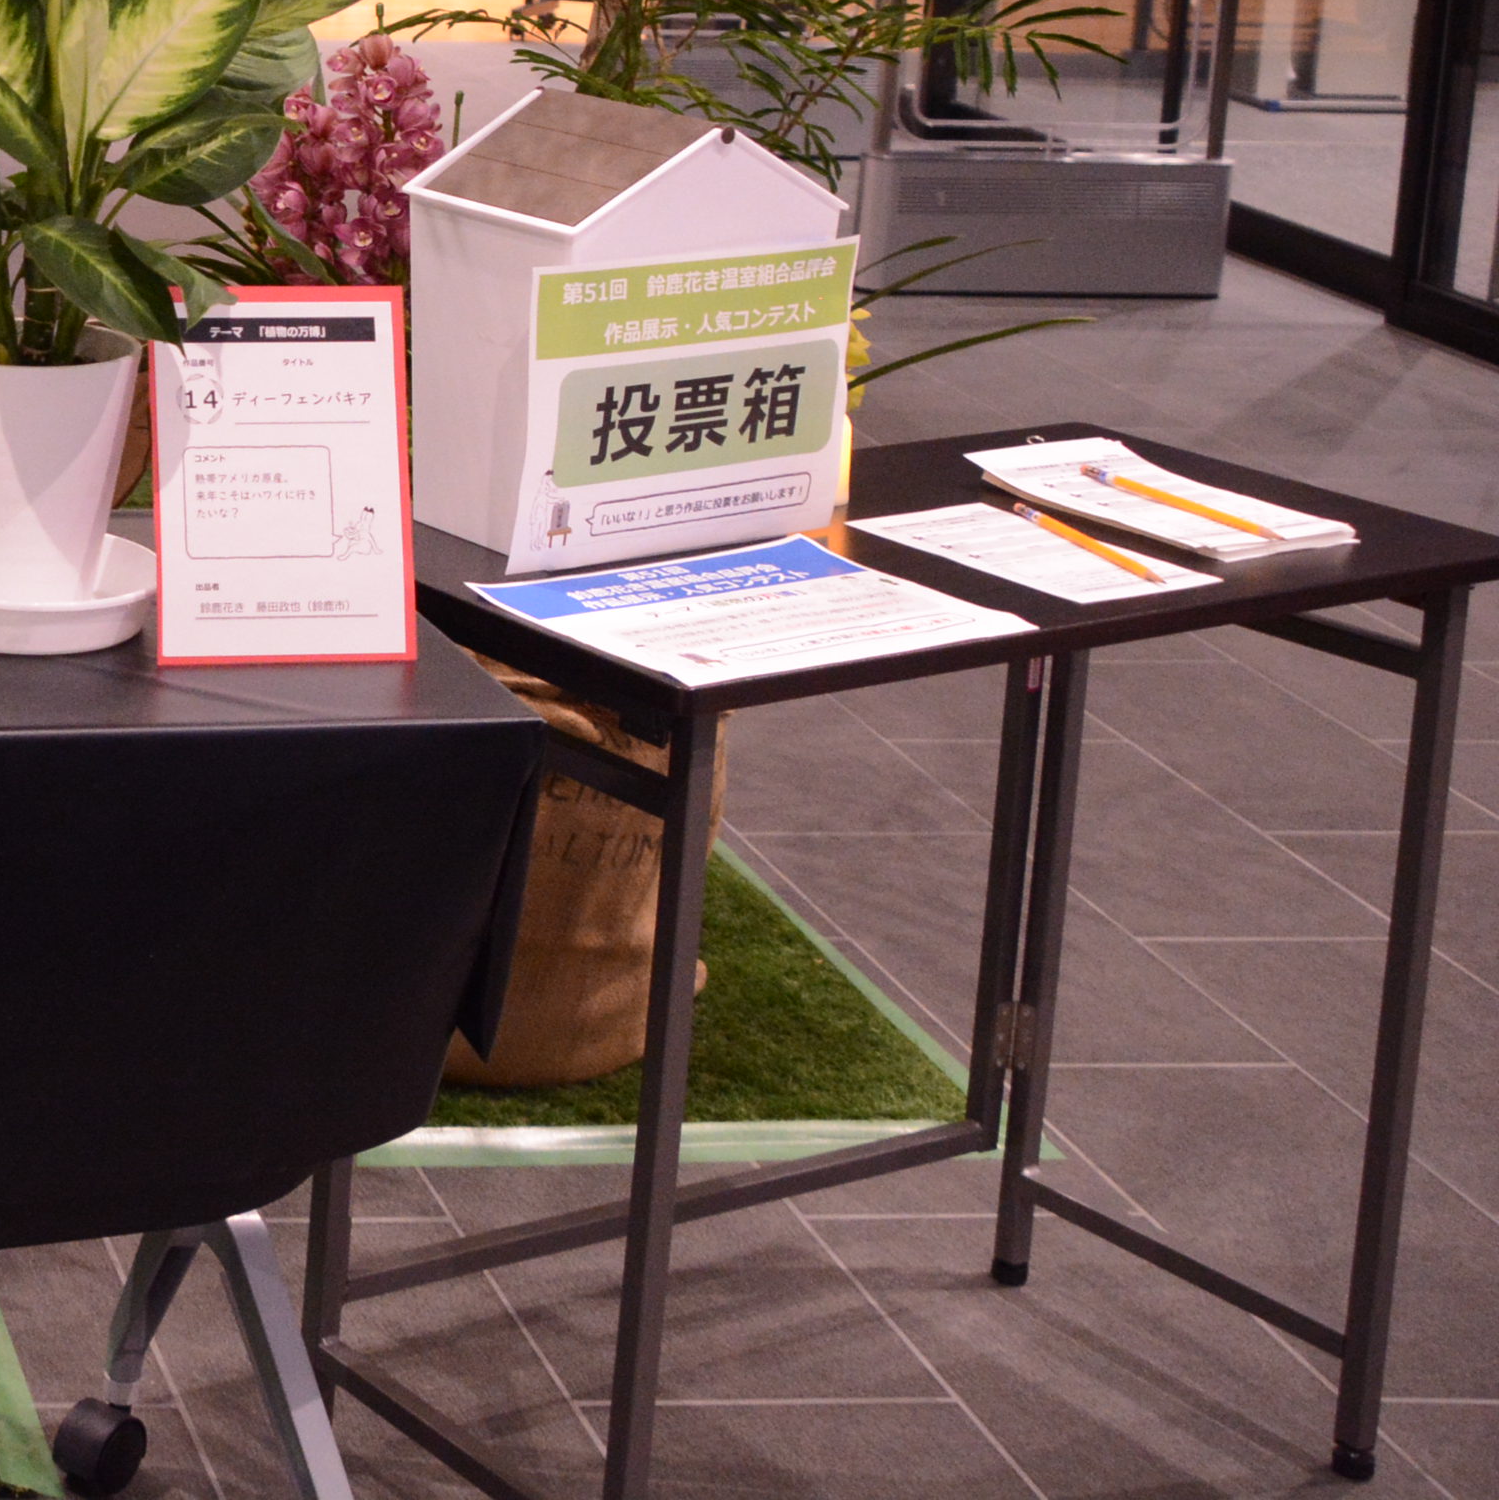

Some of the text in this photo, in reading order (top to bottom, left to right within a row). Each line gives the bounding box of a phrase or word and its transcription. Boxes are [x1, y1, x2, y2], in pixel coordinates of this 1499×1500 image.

[562, 257, 837, 305] 第51回 鈴鹿花き温室組合品評会
[209, 325, 327, 339] テーマ 「植物の万博」
[604, 301, 816, 346] 作品展示・人気コンテスト
[282, 358, 314, 367] タイトル
[184, 389, 372, 410] 14 ディーフェンバキア
[590, 364, 806, 466] 投票箱
[194, 455, 225, 463] コメント
